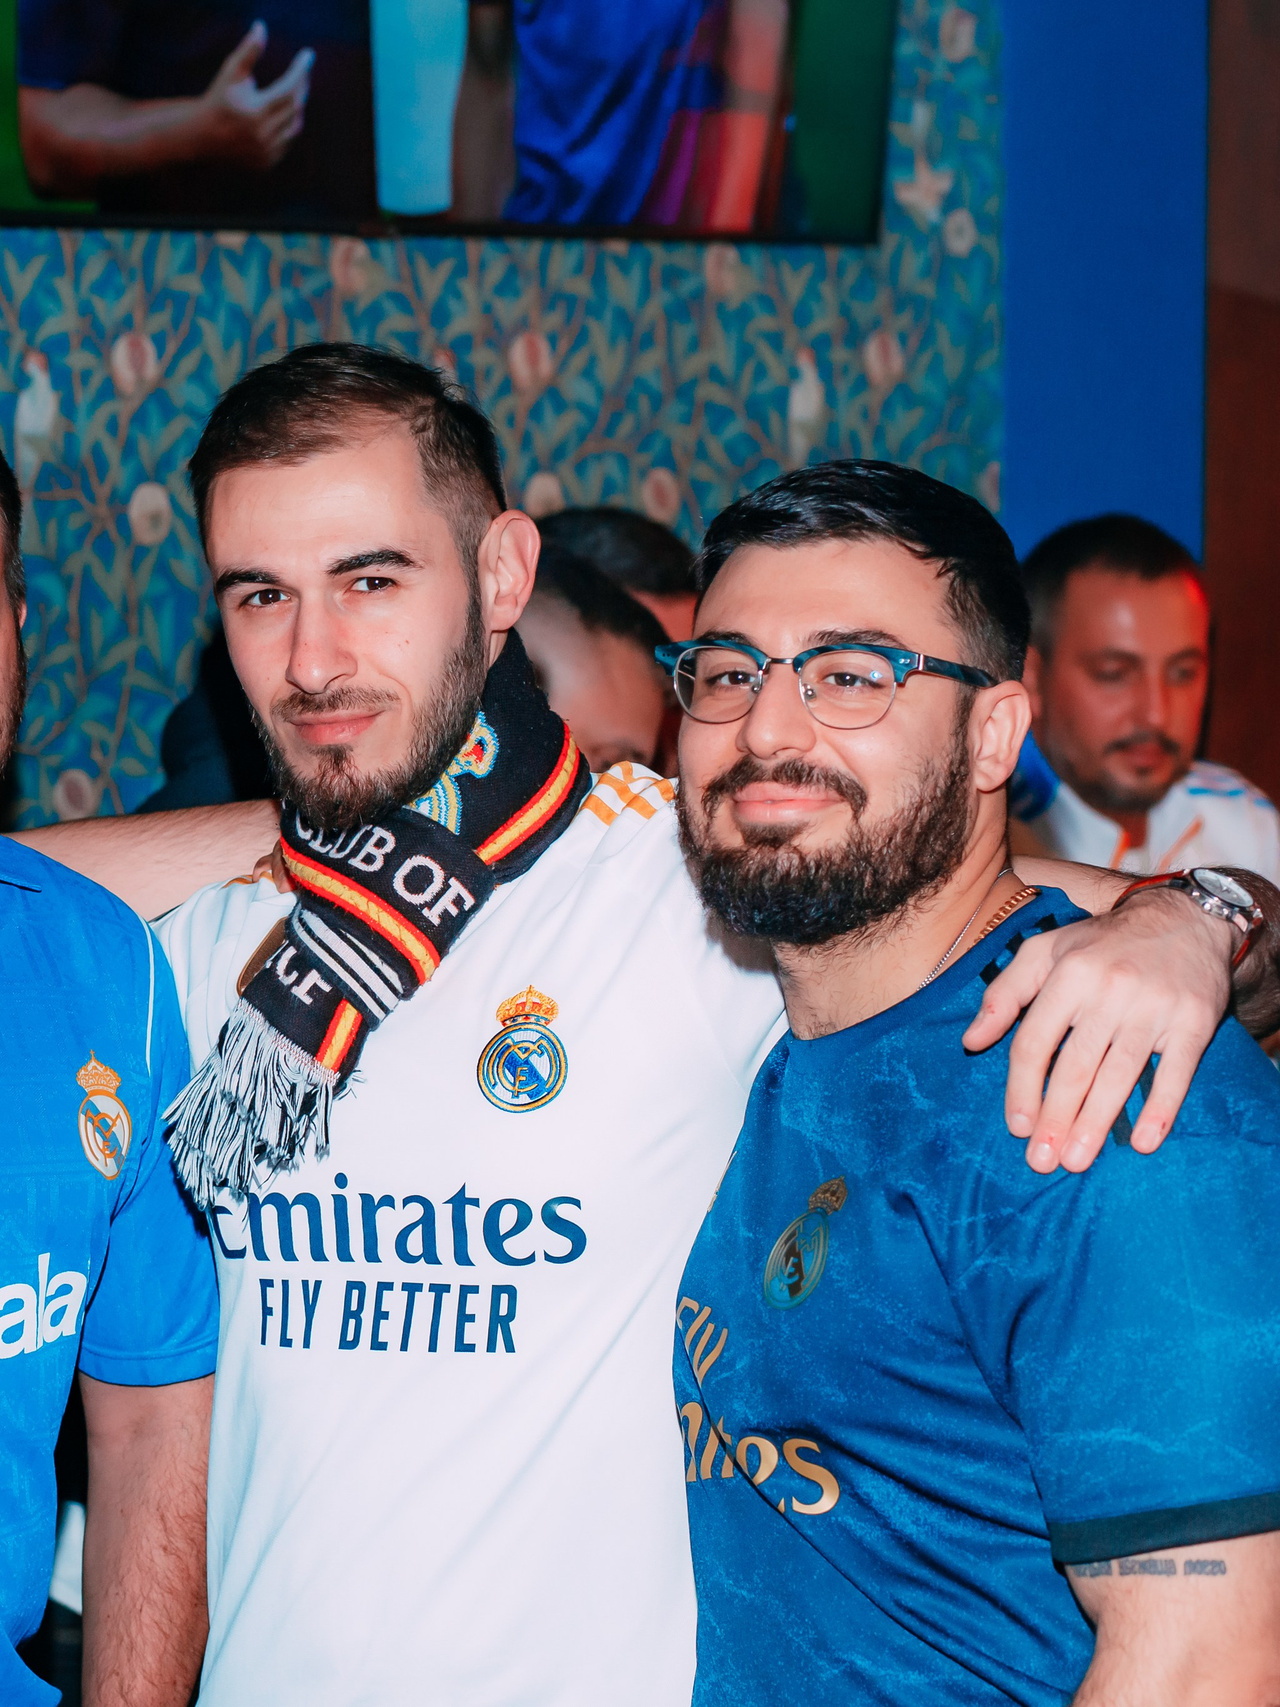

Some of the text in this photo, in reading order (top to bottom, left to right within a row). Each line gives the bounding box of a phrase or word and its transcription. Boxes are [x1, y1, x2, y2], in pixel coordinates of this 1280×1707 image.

[393, 855, 475, 927] OF
[213, 1172, 587, 1266] Emirates
[259, 1278, 518, 1353] FLY BETTER
